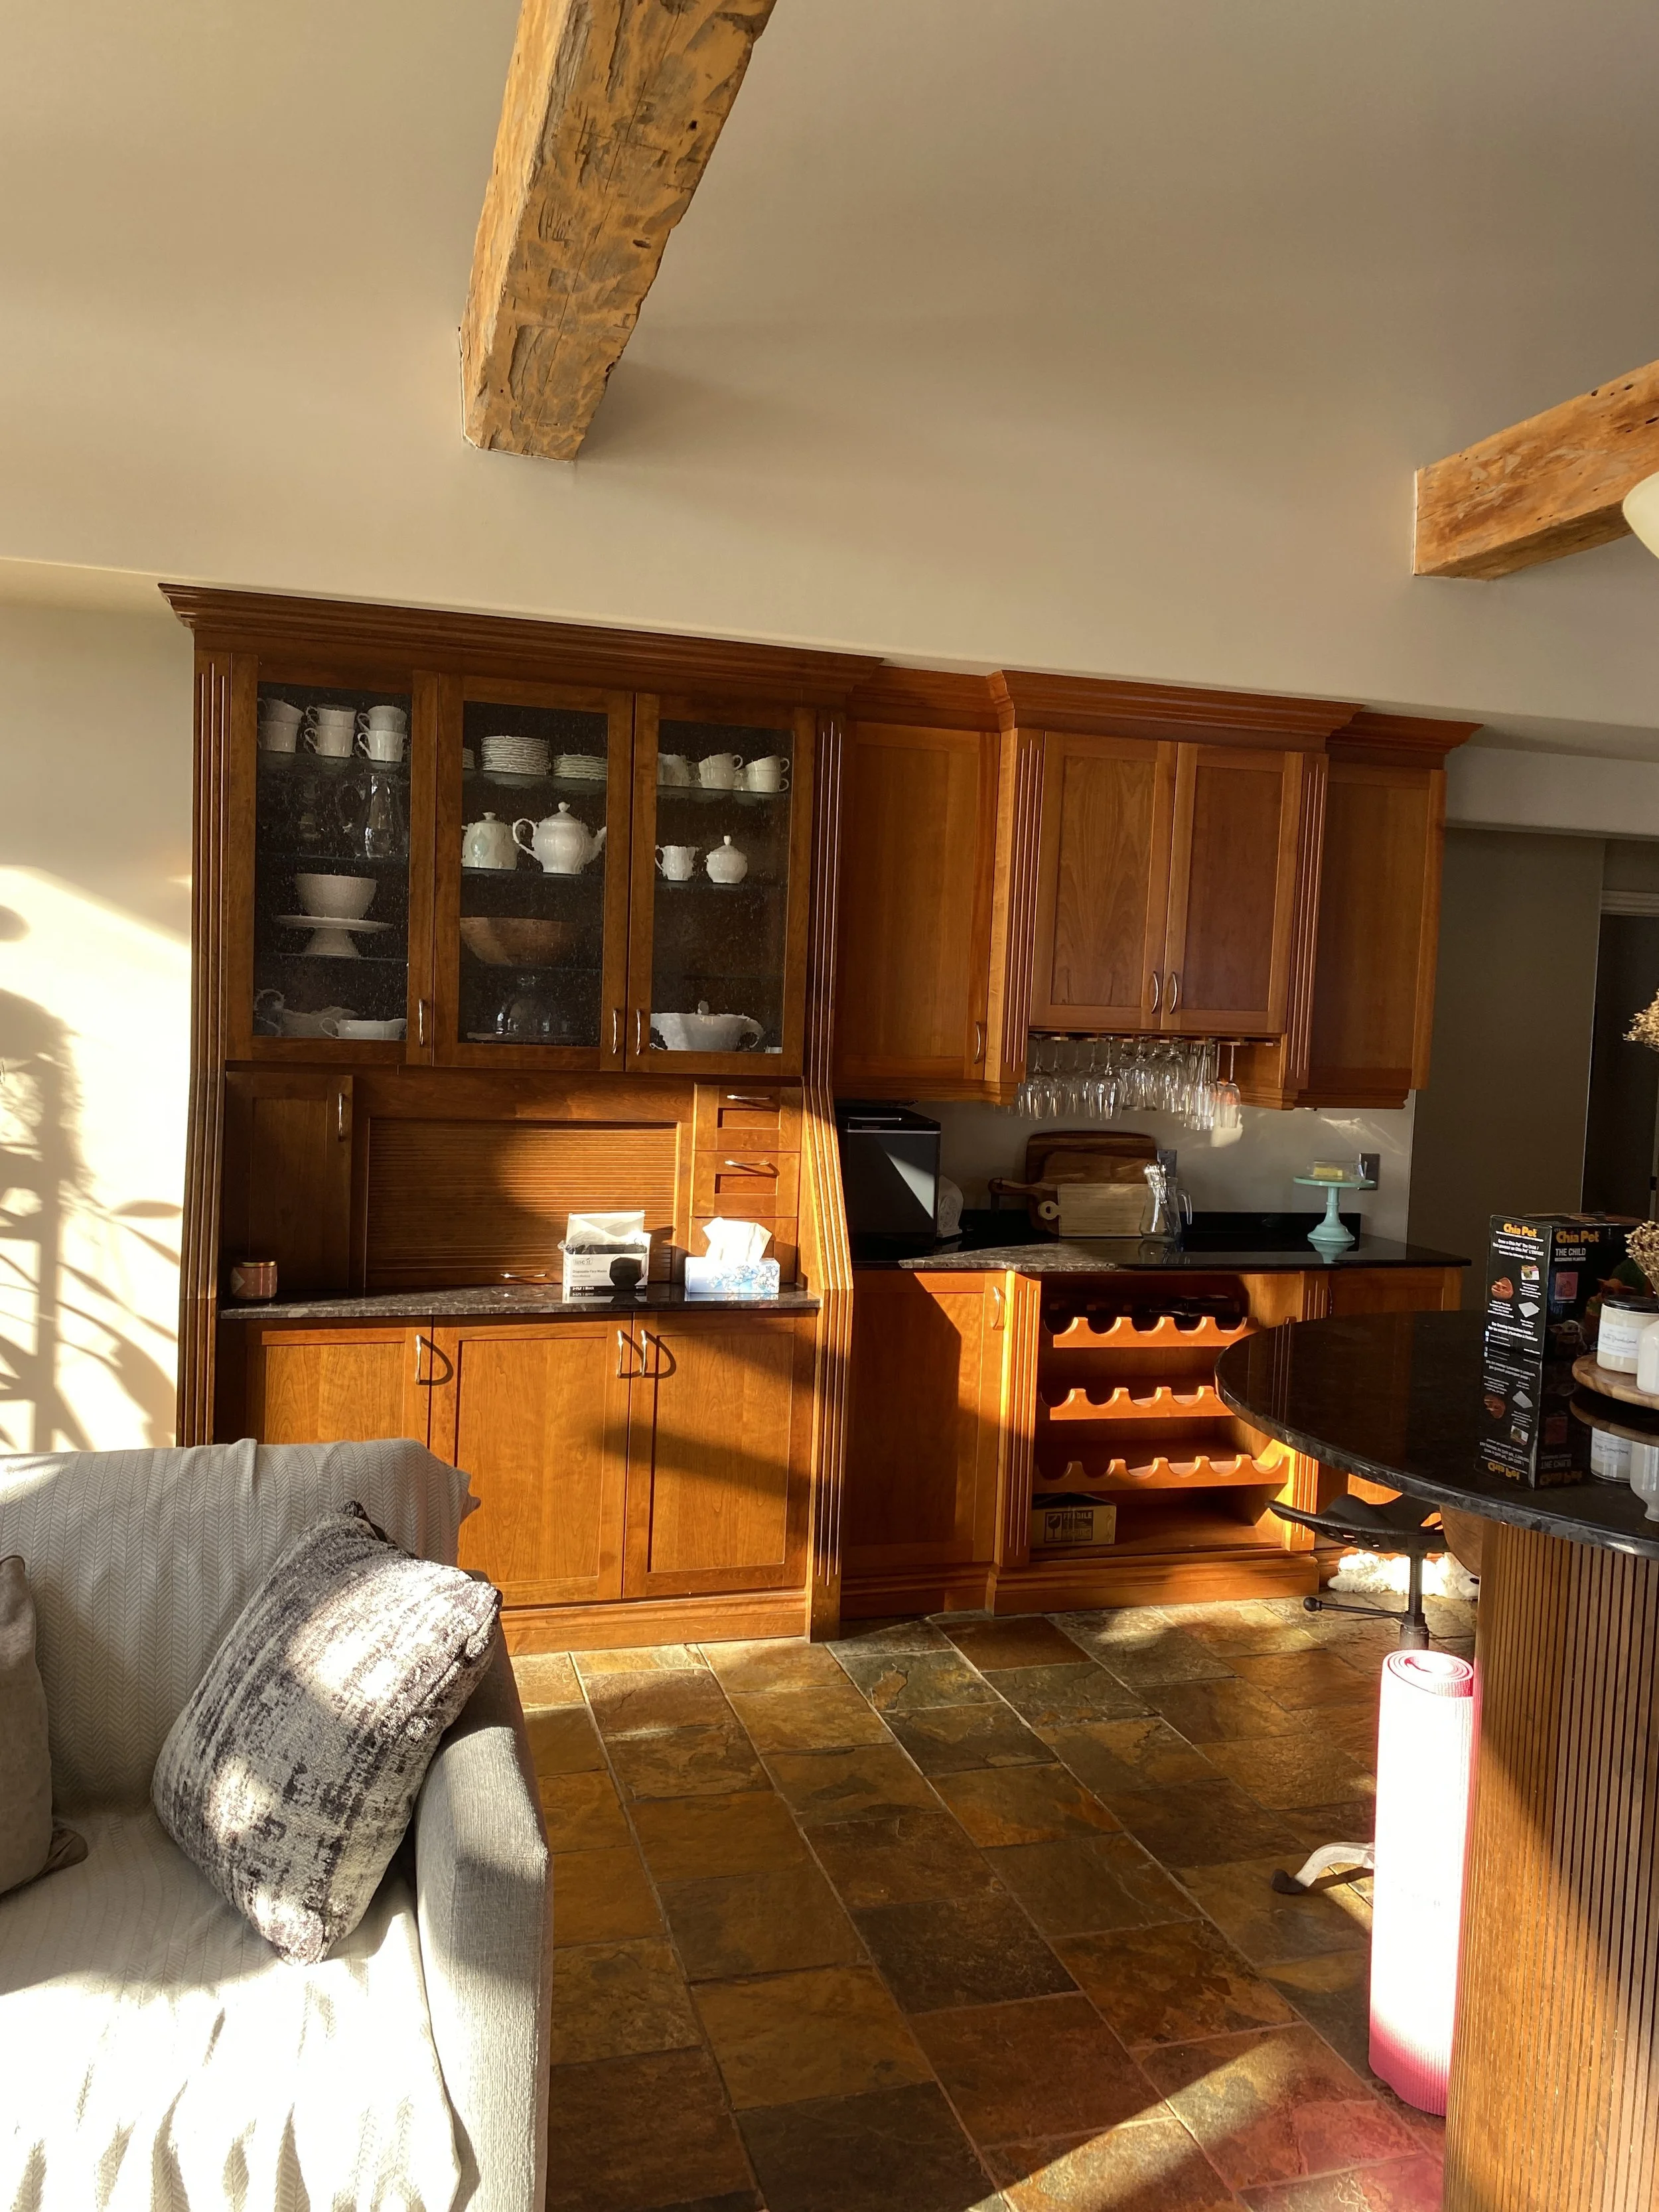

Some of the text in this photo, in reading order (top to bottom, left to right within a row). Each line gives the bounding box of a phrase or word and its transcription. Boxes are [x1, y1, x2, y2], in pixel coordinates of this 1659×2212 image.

[1503, 1223, 1537, 1238] Chia Pet
[1555, 1230, 1579, 1244] Chia
[1581, 1230, 1599, 1242] Pet
